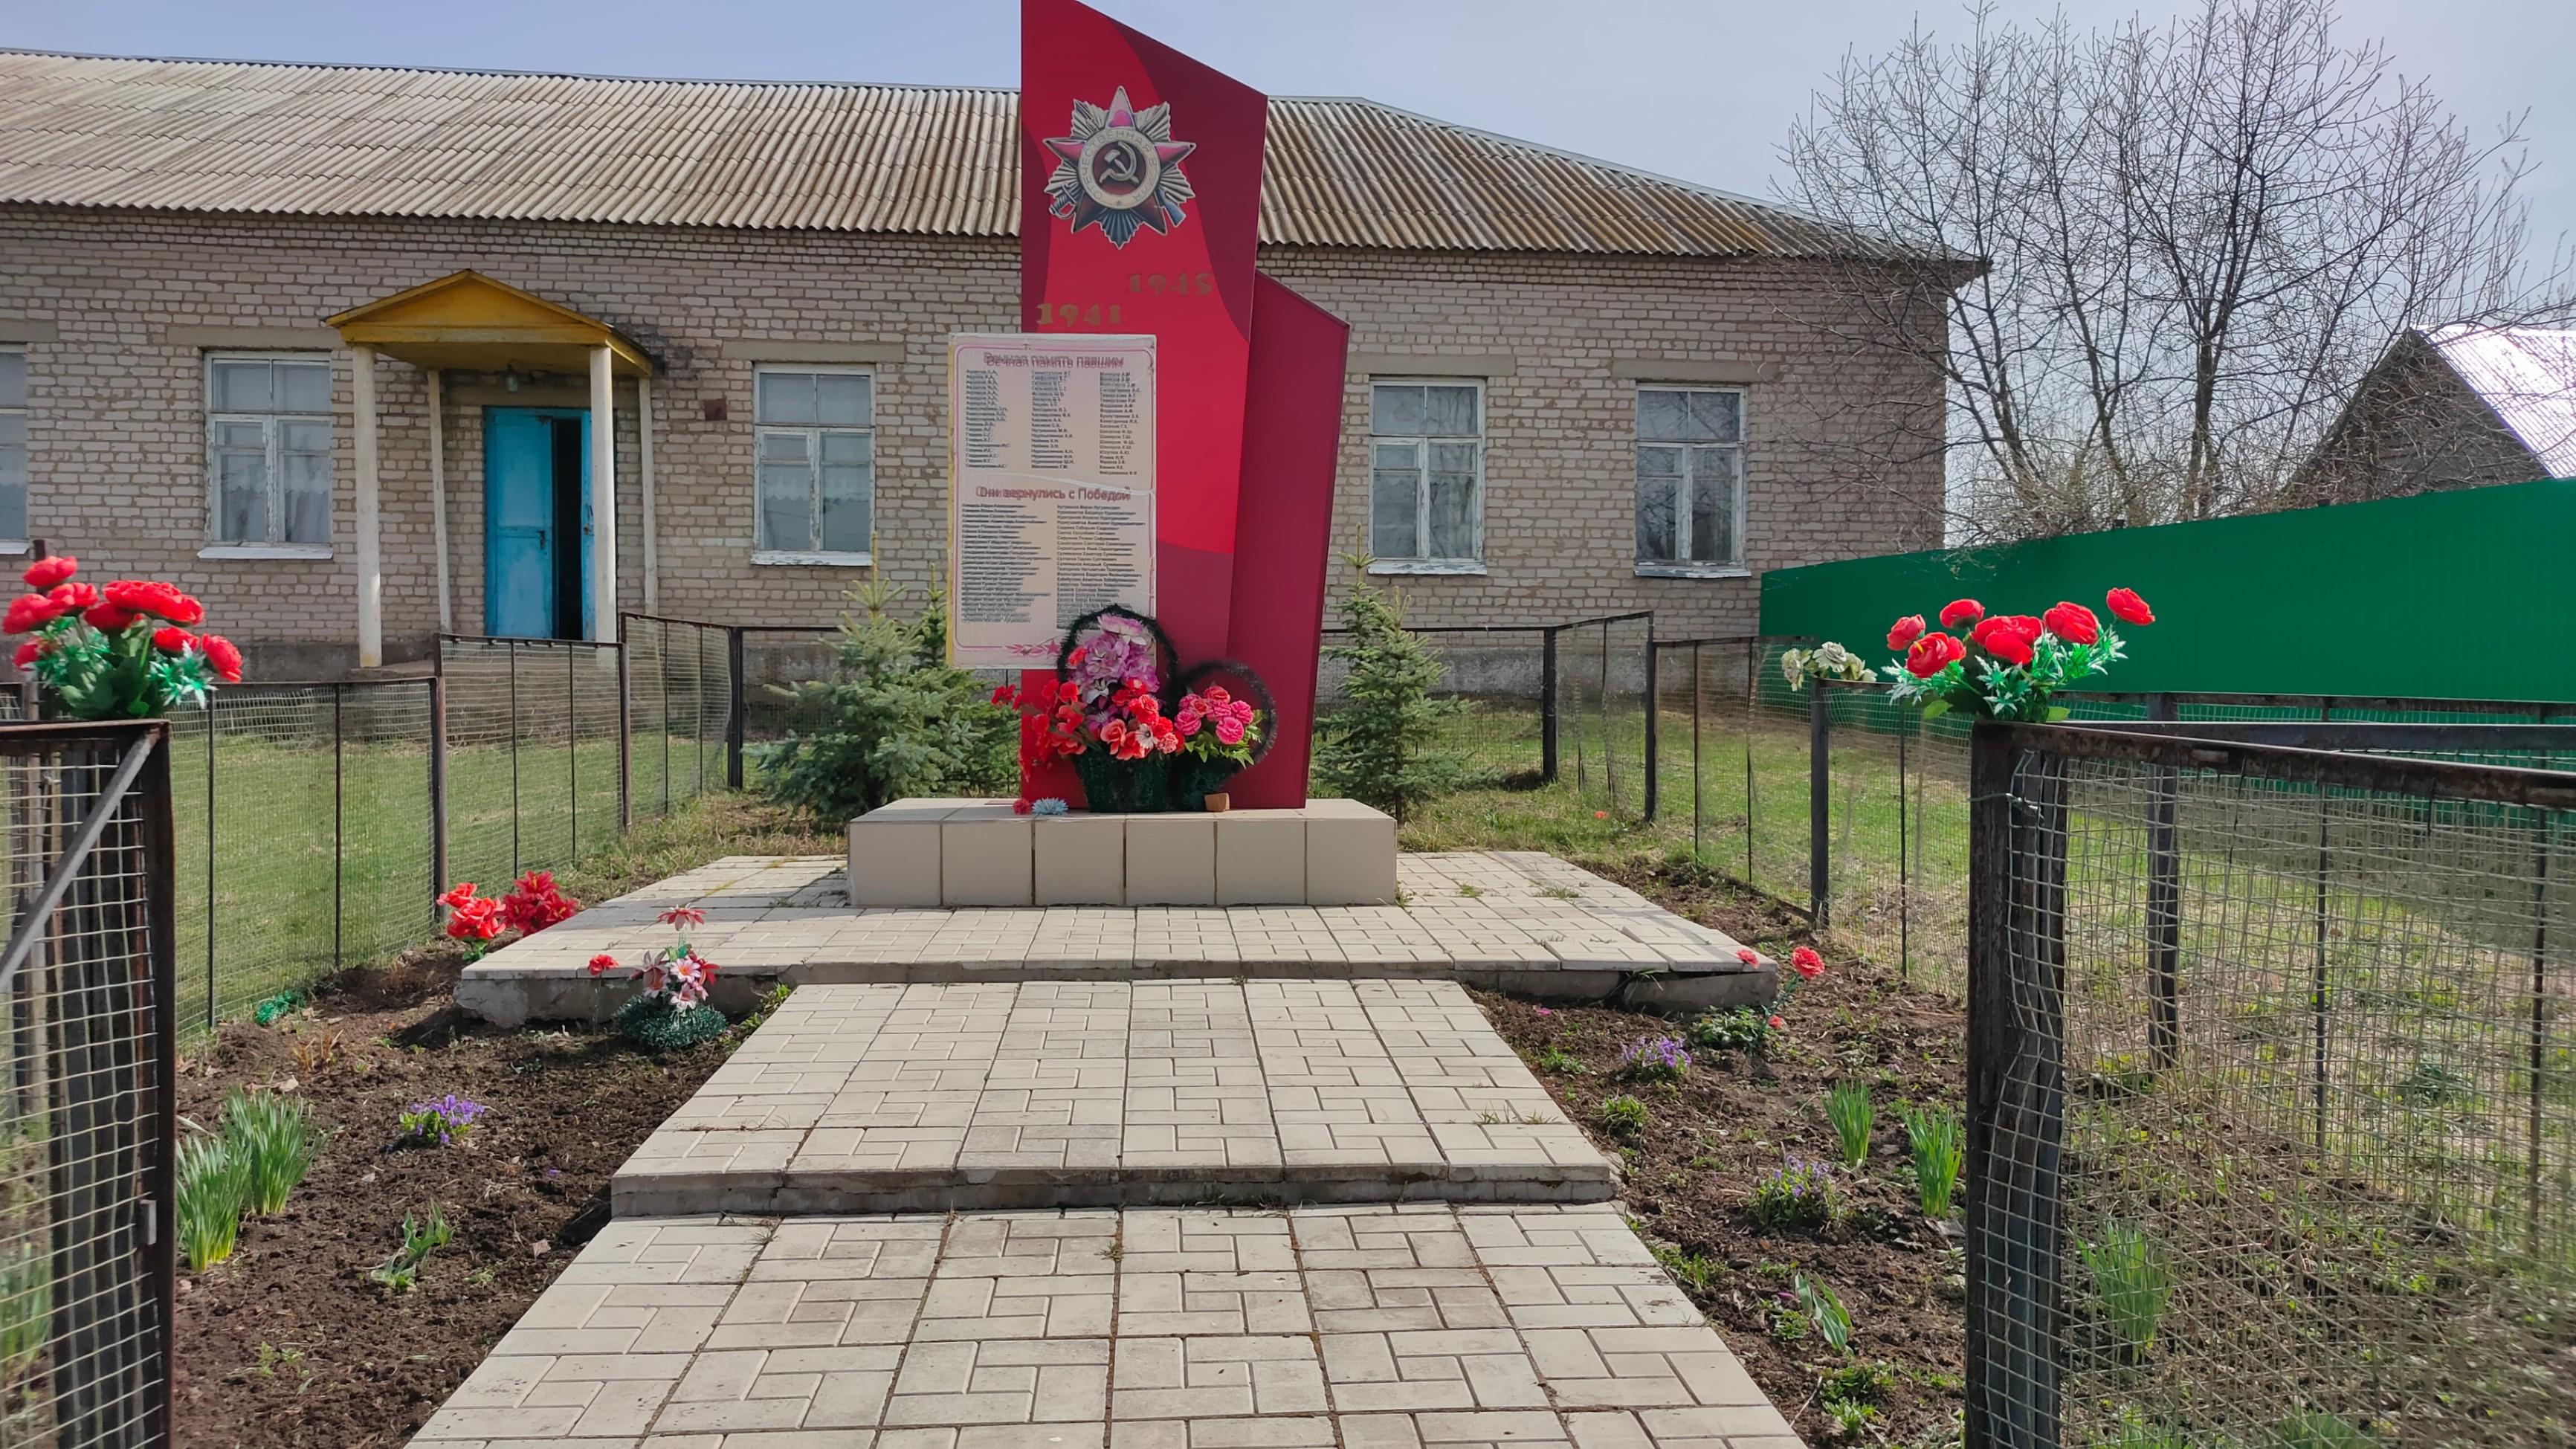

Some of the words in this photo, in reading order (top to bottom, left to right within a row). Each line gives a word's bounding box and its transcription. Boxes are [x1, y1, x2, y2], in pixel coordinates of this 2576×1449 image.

[1126, 273, 1213, 297] 1945
[1036, 303, 1123, 327] 1941
[984, 352, 1029, 367] Вечная
[1031, 355, 1074, 368] память
[1076, 355, 1124, 368] павшим
[976, 486, 1002, 498] Они
[1003, 488, 1065, 501] вернулись
[1069, 489, 1075, 499] с
[1078, 486, 1132, 502] Победой
